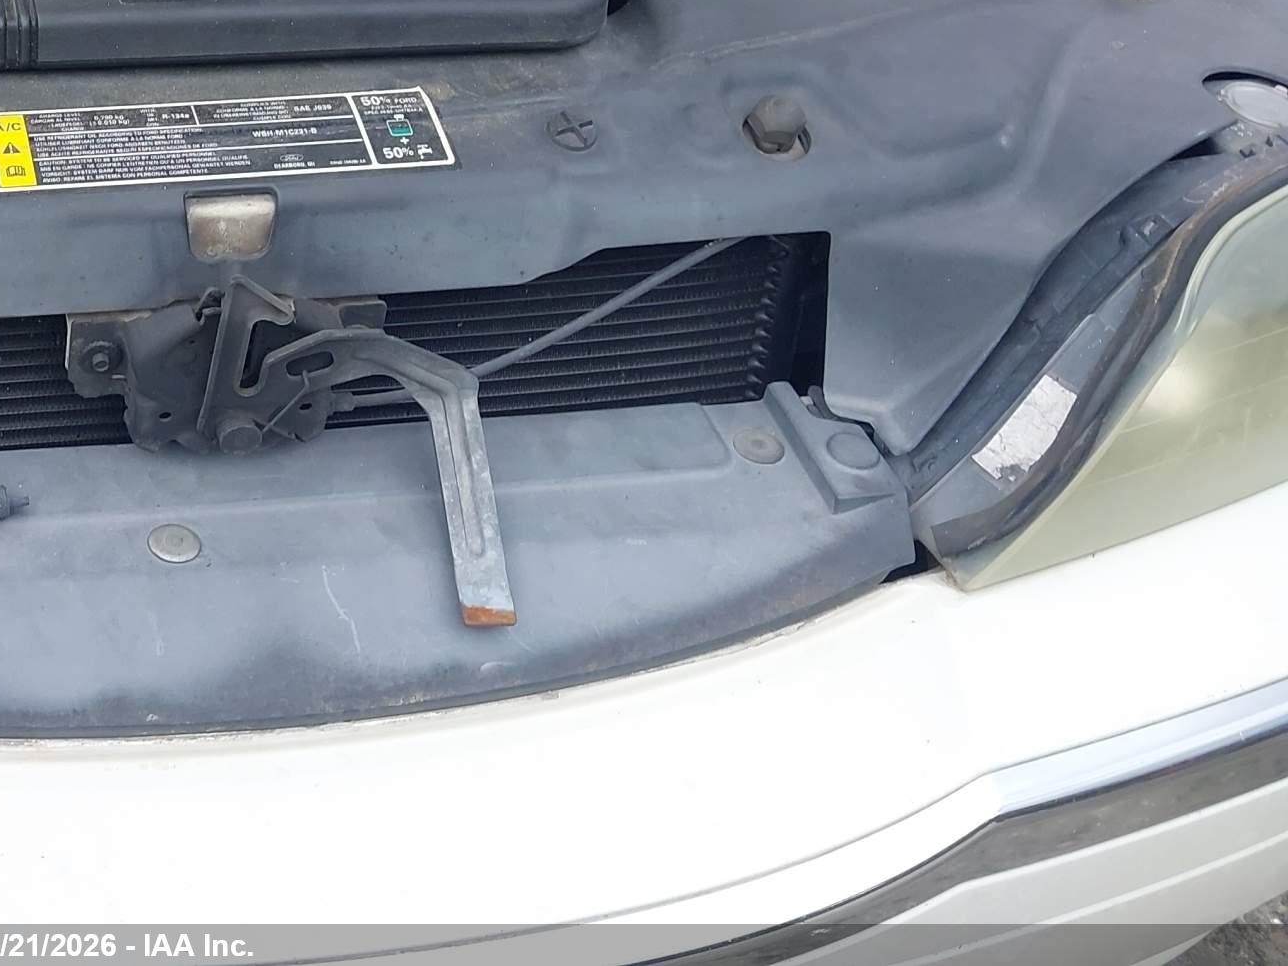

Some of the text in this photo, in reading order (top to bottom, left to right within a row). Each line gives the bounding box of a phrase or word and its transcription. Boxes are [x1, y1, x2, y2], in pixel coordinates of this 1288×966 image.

[360, 96, 391, 107] 50%
[394, 97, 417, 105] FORD
[382, 146, 415, 159] 50%
